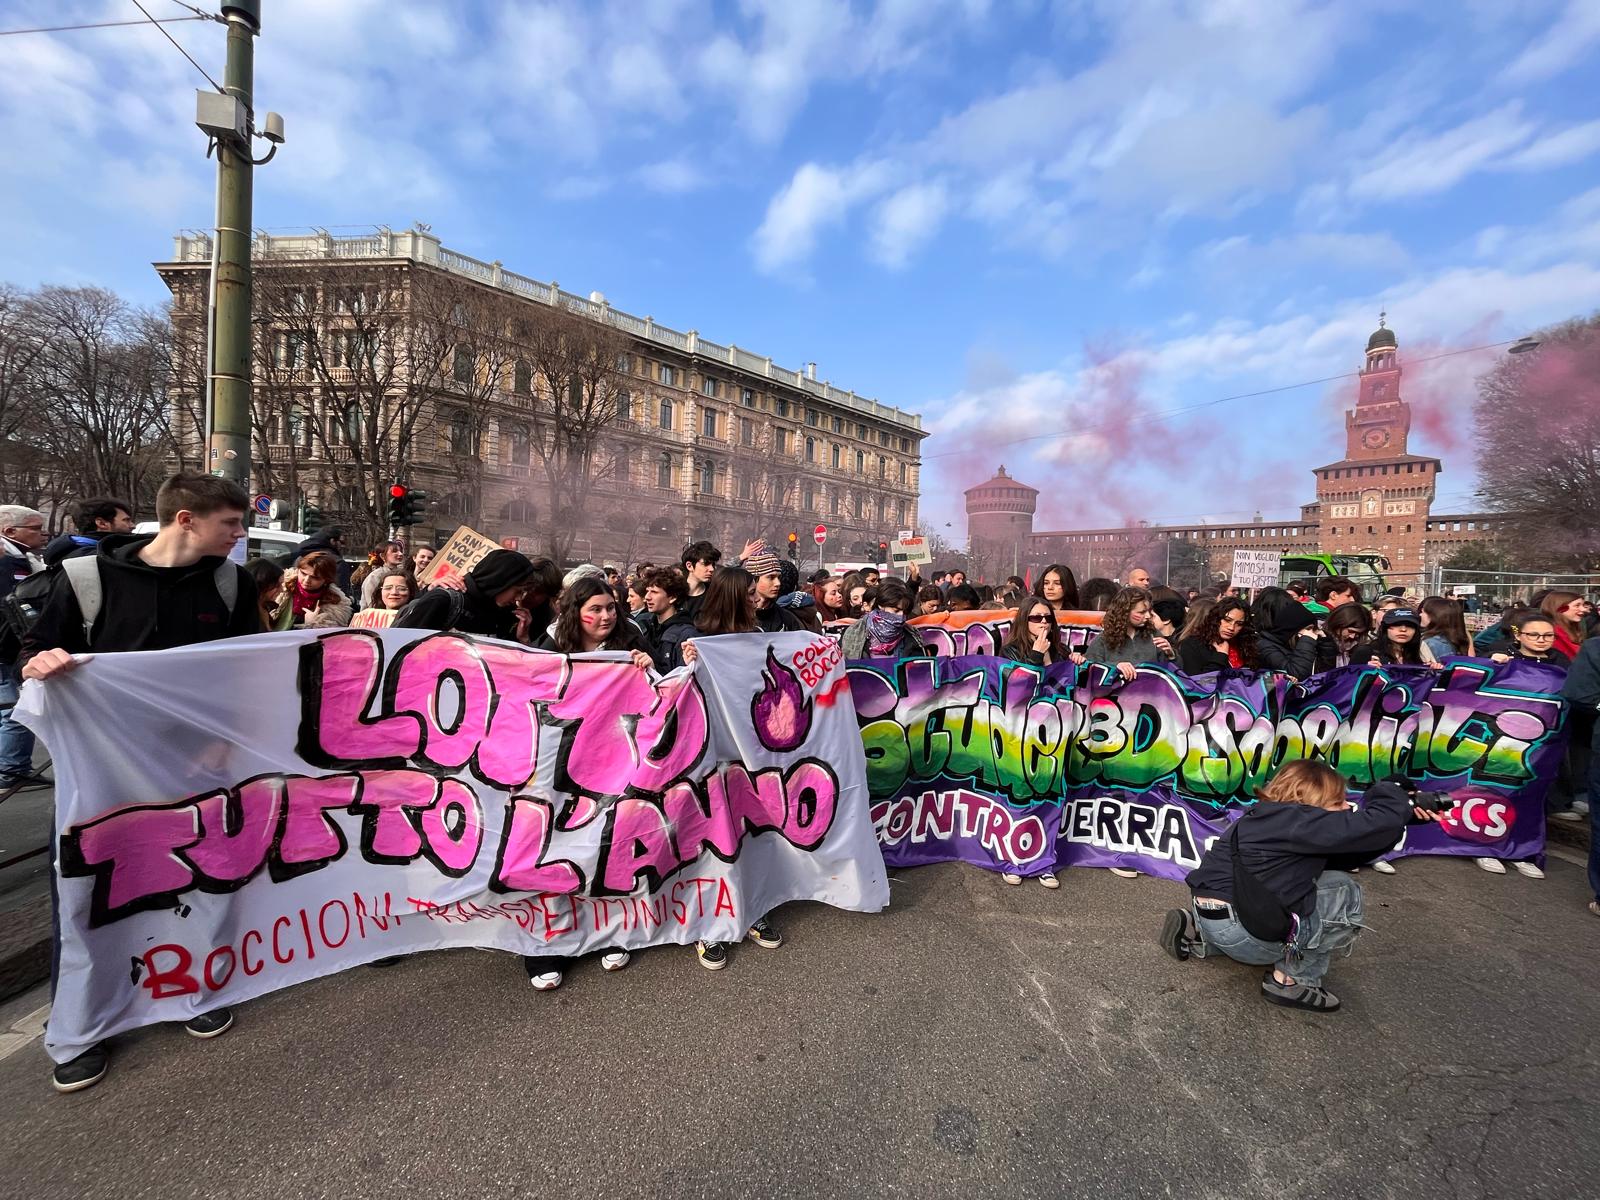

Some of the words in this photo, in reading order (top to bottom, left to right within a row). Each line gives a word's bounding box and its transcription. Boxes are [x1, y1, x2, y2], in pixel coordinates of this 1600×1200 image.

[451, 541, 473, 559] YOU
[462, 534, 493, 555] ANYT
[446, 552, 466, 568] WE
[1236, 551, 1251, 561] NON
[1234, 561, 1266, 574] MIMOSA
[296, 629, 711, 797] LOTTO
[869, 789, 1048, 866] CONTRO
[1057, 796, 1202, 870] UERRA
[60, 769, 485, 928] TUTTO
[488, 757, 840, 898] L'ANNO
[142, 891, 402, 1000] BOCCIONI
